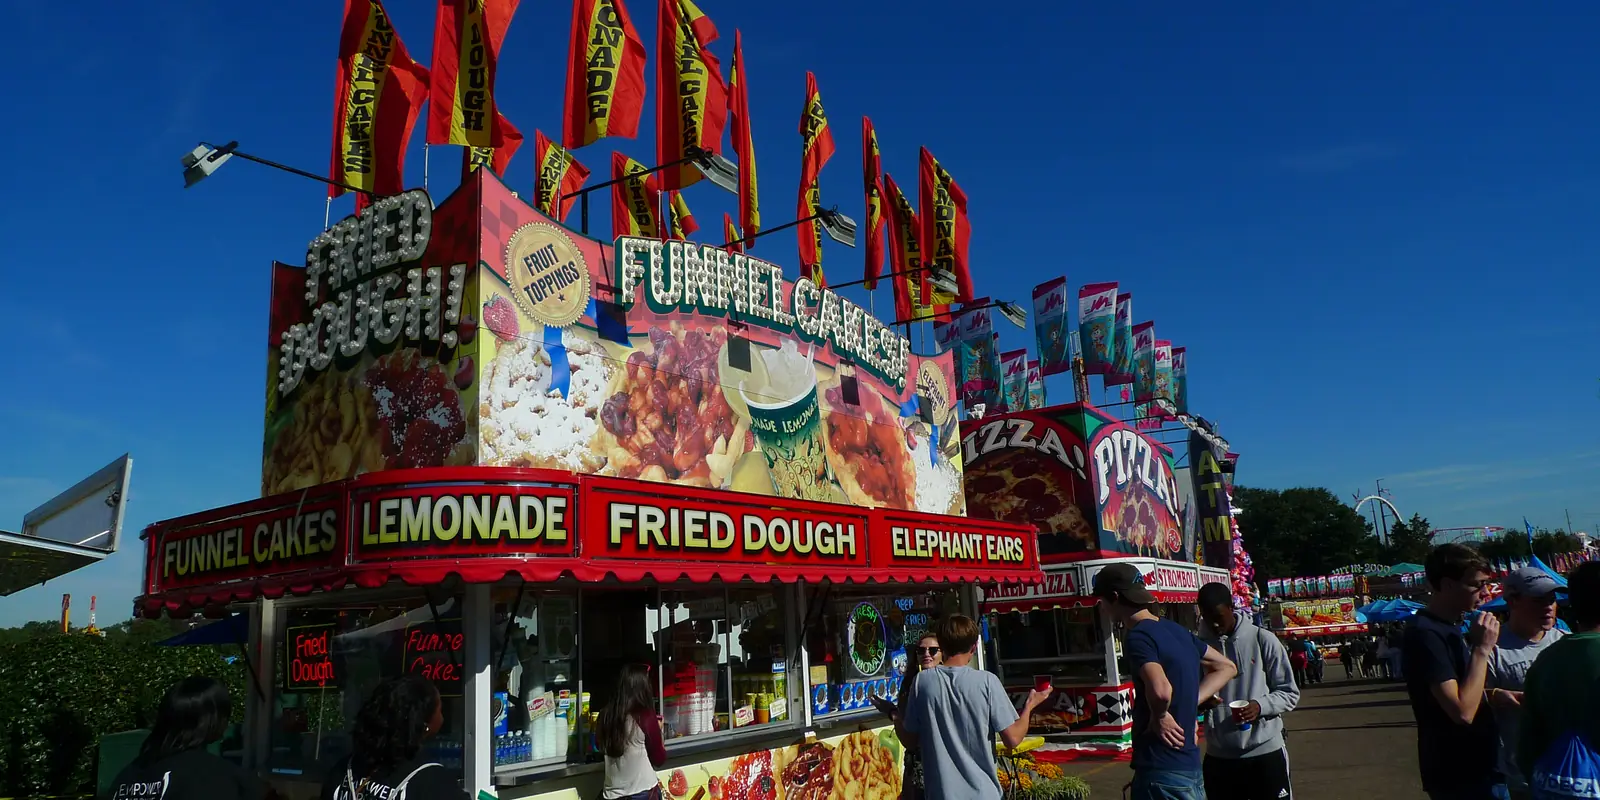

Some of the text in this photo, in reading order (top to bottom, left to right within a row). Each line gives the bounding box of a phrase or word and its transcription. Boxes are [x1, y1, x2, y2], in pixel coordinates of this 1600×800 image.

[345, 88, 375, 174] CAKES
[679, 80, 701, 163] CAKE
[305, 189, 432, 306] FRIED
[523, 243, 559, 276] FRUIT
[523, 260, 581, 306] TOPPINGS
[278, 264, 466, 397] DOUGH!
[621, 237, 796, 326] FUNNEL
[794, 278, 909, 389] CAKES!
[963, 420, 1087, 480] IZZA!
[1093, 429, 1181, 528] PIZZA!
[1197, 449, 1232, 541] ATM
[163, 509, 337, 578] FUNNEL CAKES
[361, 494, 568, 546] LEMONADE
[609, 501, 857, 556] FRIED DOUGH
[890, 526, 1025, 562] ELEPHANT EARS
[852, 604, 878, 623] FRESH
[904, 613, 927, 625] FRIED
[1295, 605, 1322, 616] FRENCH
[295, 627, 328, 658] Fried
[291, 656, 335, 687] Dough
